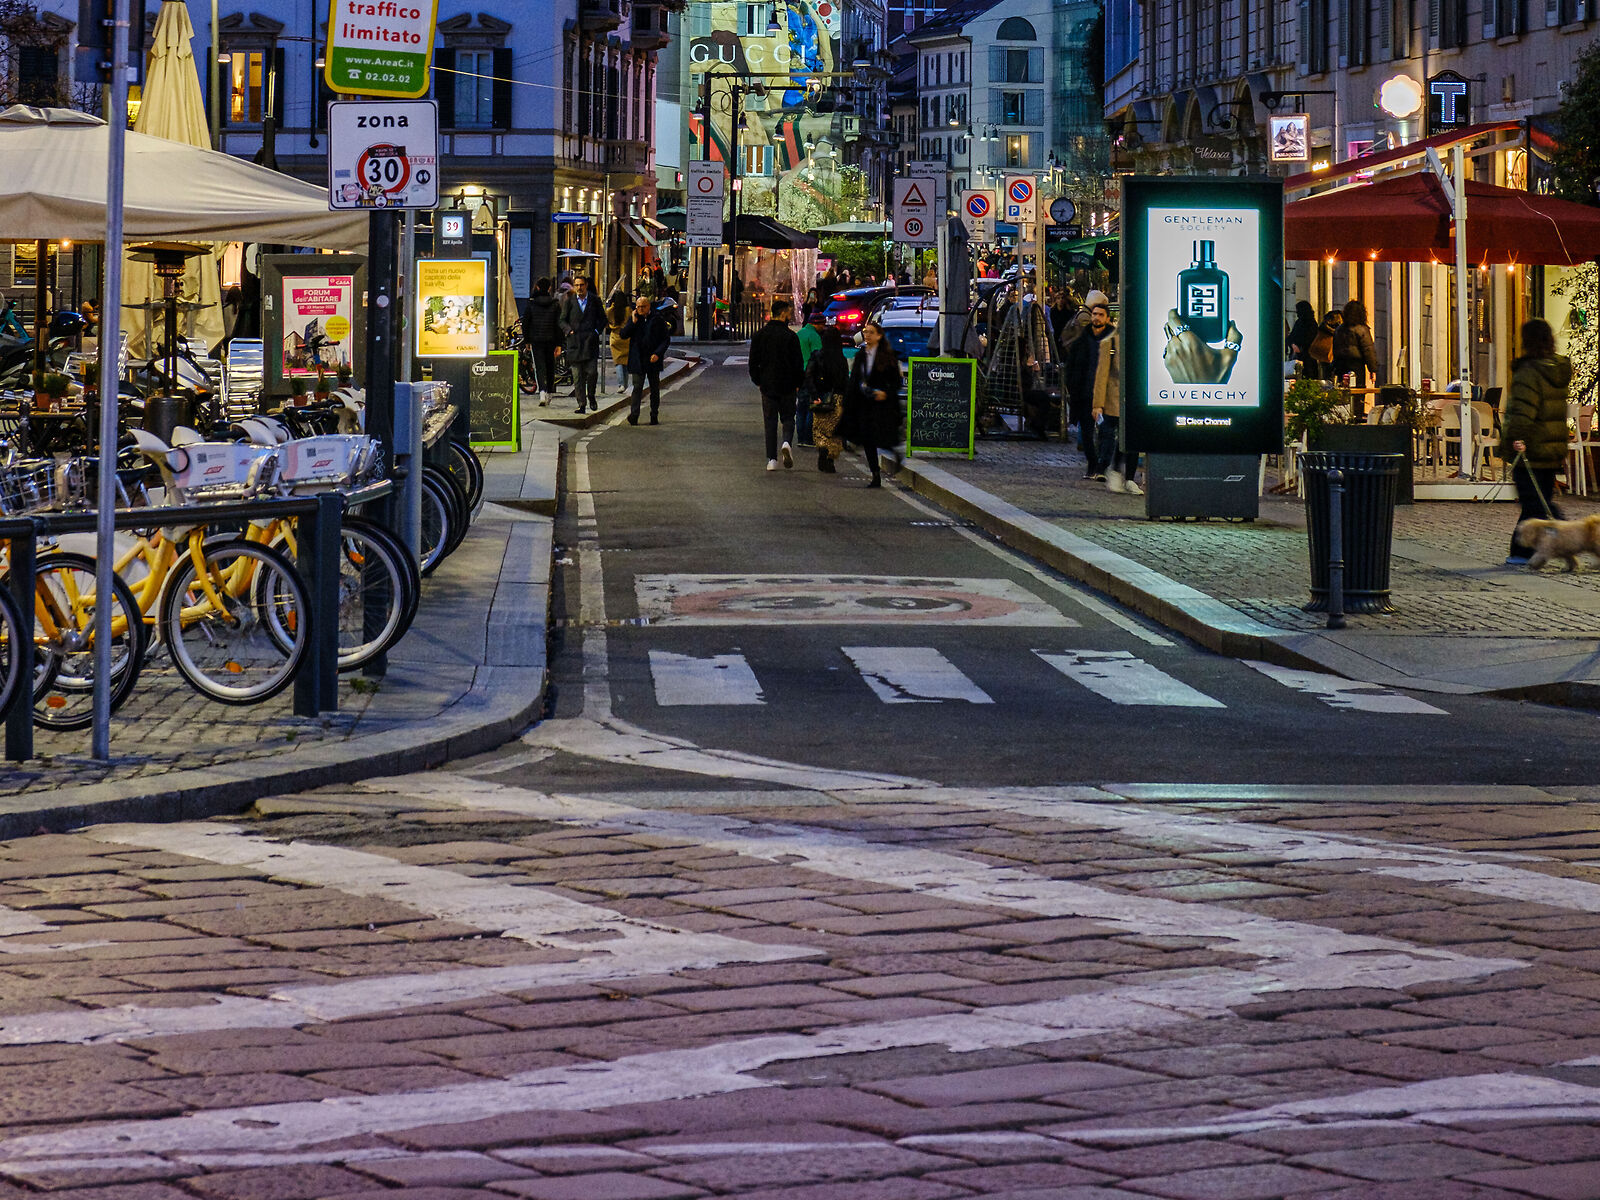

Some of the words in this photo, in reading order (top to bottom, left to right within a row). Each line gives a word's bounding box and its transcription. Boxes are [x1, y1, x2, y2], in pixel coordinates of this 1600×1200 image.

[348, 1, 421, 20] traffico
[343, 23, 421, 44] limitato
[690, 43, 807, 64] GUCCI
[345, 56, 415, 68] www.AreaC.it
[365, 72, 411, 83] 02.02.02
[1431, 82, 1466, 123] T
[357, 115, 409, 128] zona
[368, 158, 399, 183] 30
[1164, 215, 1243, 224] GENTLEMAN
[446, 221, 459, 232] 39
[908, 223, 920, 231] 30
[1159, 390, 1247, 400] GIVENCHY
[502, 407, 511, 424] 8
[1186, 417, 1204, 426] Clear
[1204, 417, 1231, 426] Channel
